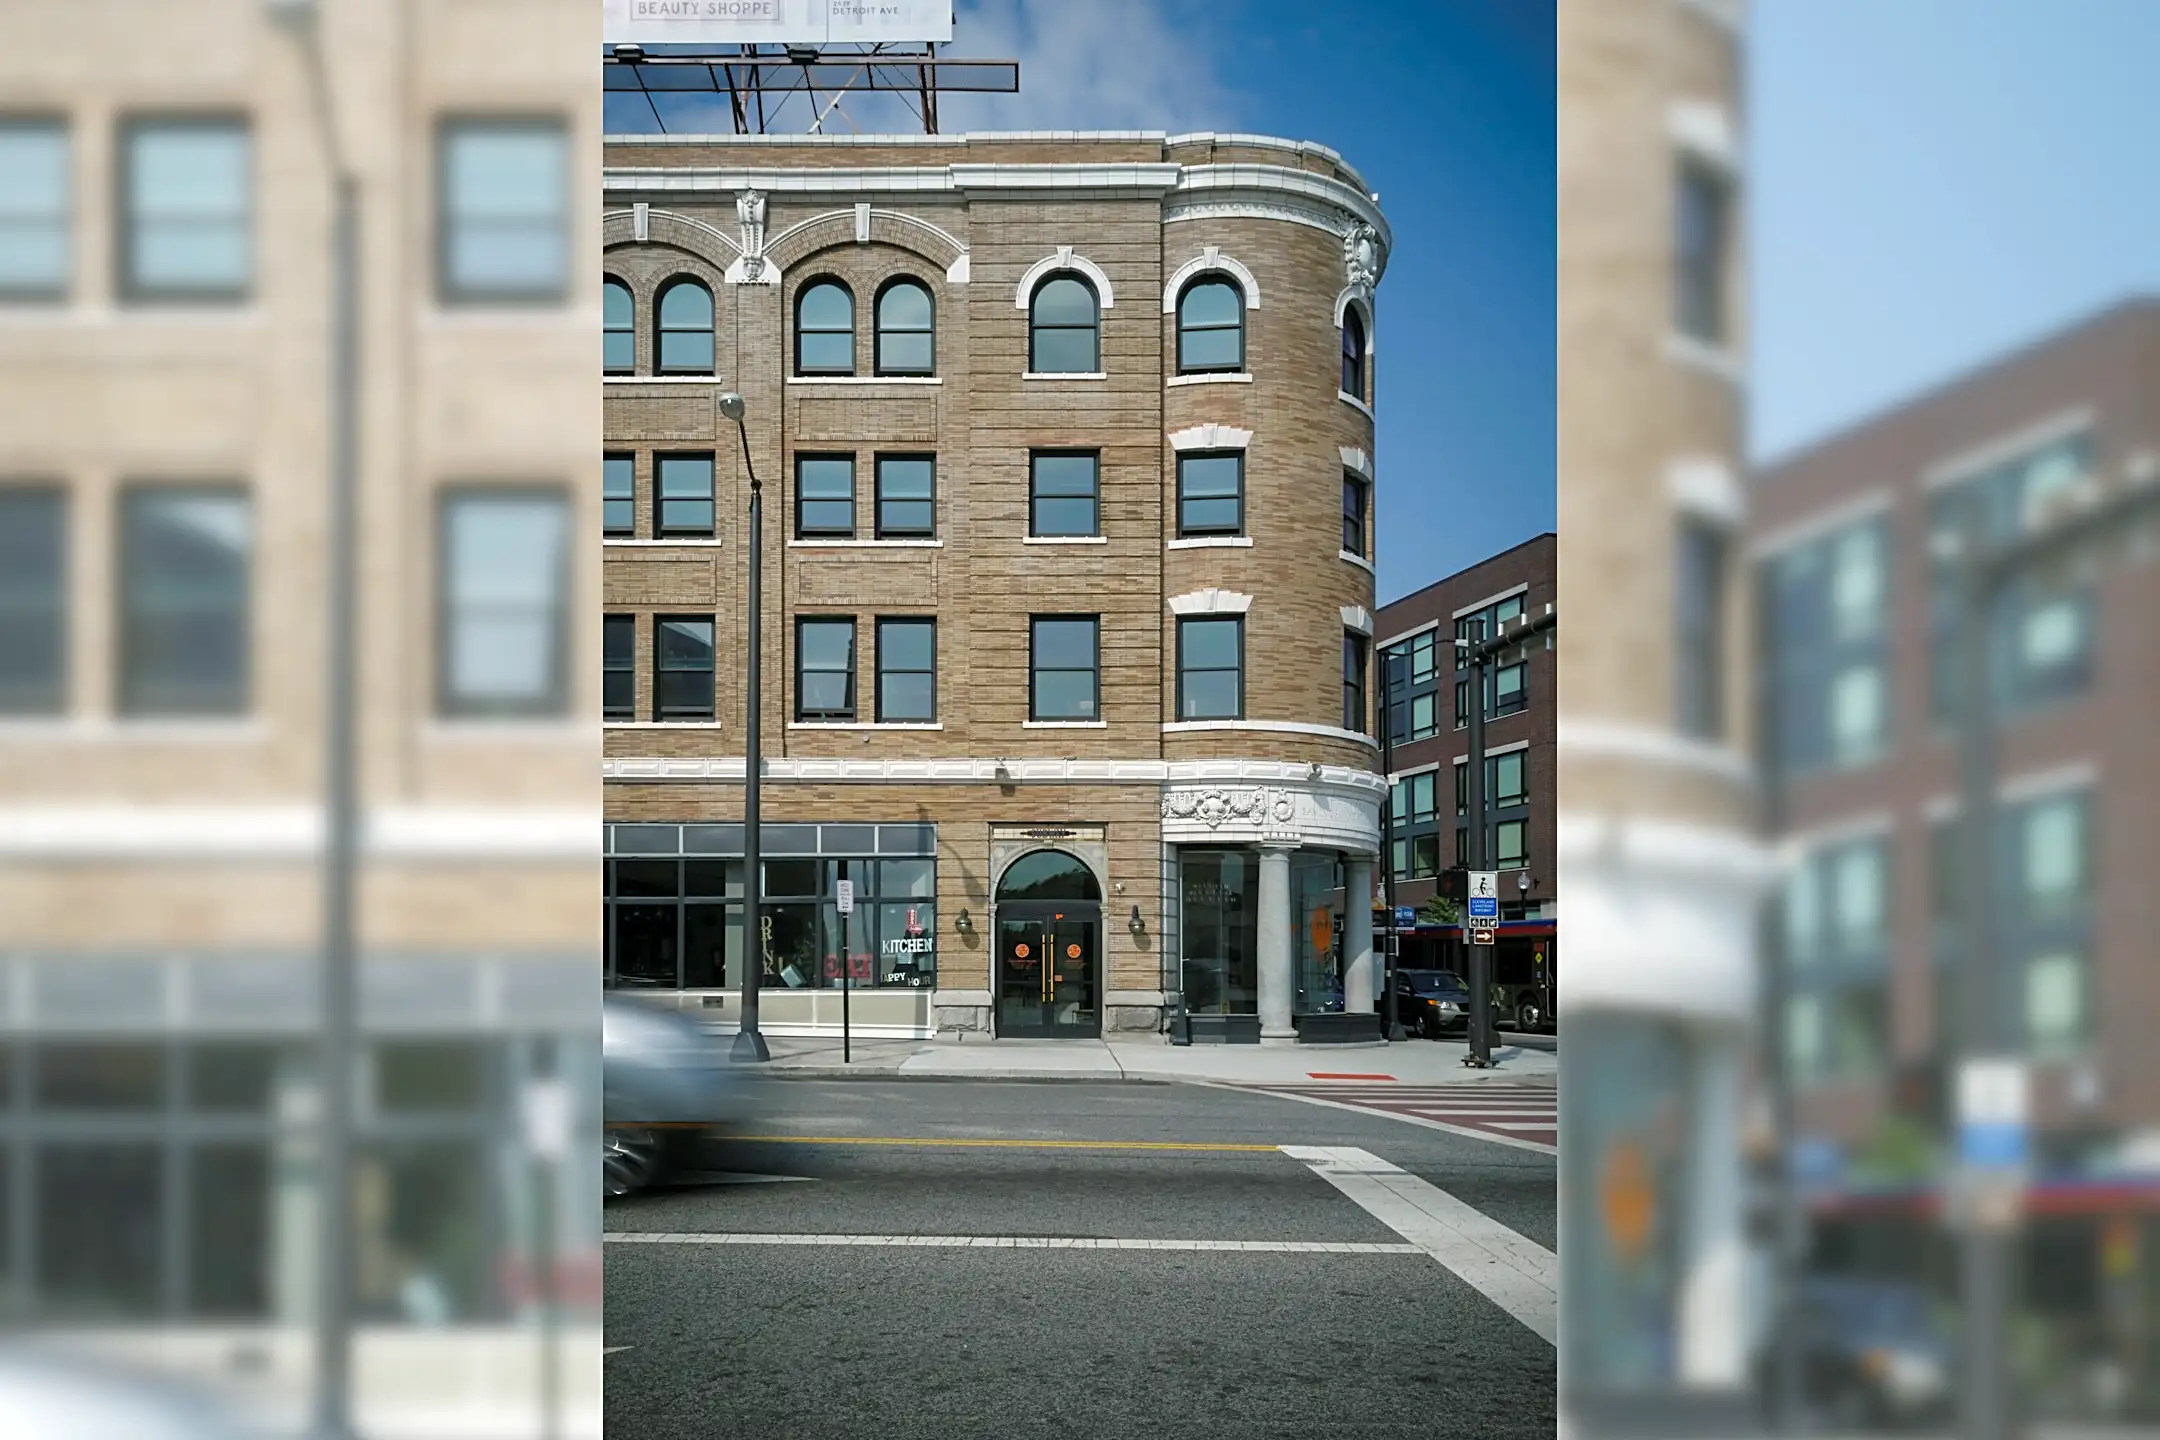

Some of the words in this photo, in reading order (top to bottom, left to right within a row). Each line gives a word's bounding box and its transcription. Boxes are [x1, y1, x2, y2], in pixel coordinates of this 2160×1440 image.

[638, 2, 700, 15] BEAUTY
[708, 2, 772, 15] SHOPPE
[833, 7, 876, 15] DETROIT
[880, 7, 899, 15] AVE
[760, 915, 774, 975] DRINK
[882, 938, 933, 954] KITCHEN
[823, 953, 873, 978] EAT
[907, 976, 931, 987] HOUR
